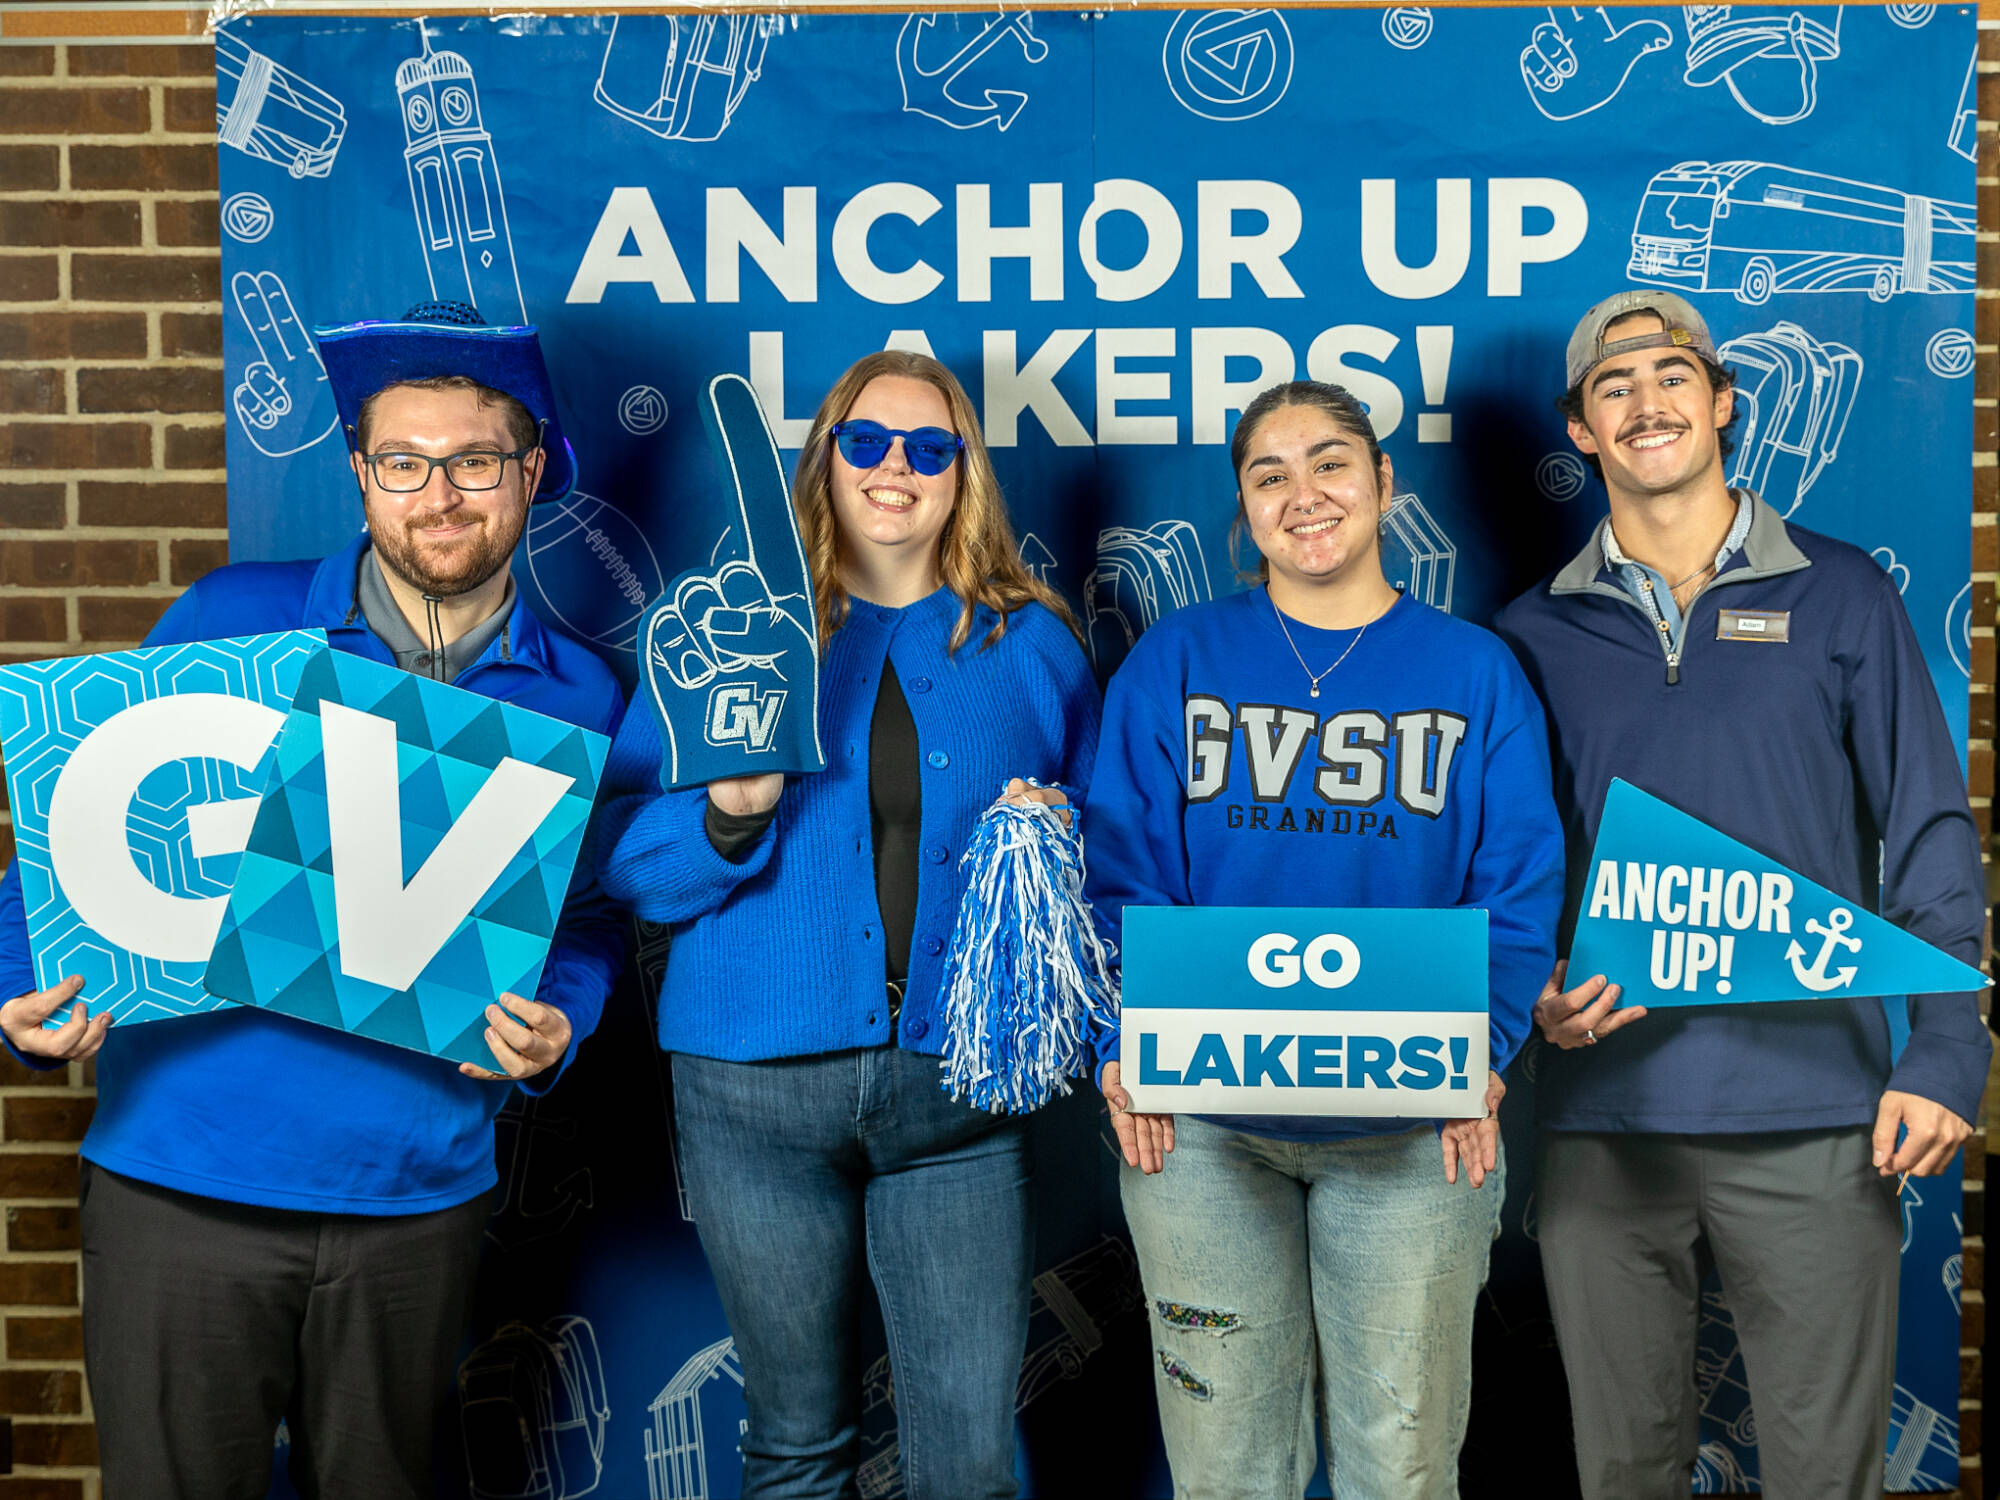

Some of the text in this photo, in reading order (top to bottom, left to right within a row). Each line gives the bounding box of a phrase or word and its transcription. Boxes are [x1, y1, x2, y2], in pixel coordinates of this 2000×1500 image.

[565, 177, 1589, 304] ANCHOR UP
[749, 324, 1454, 448] LKERS!
[704, 682, 788, 753] GV
[1185, 693, 1468, 820] GVSU
[1227, 804, 1399, 839] GRANDPA
[1588, 859, 1794, 934] ANCHOR
[1247, 932, 1361, 989] GO
[1650, 929, 1735, 995] UP!
[1139, 1032, 1469, 1090] LAKERS!
